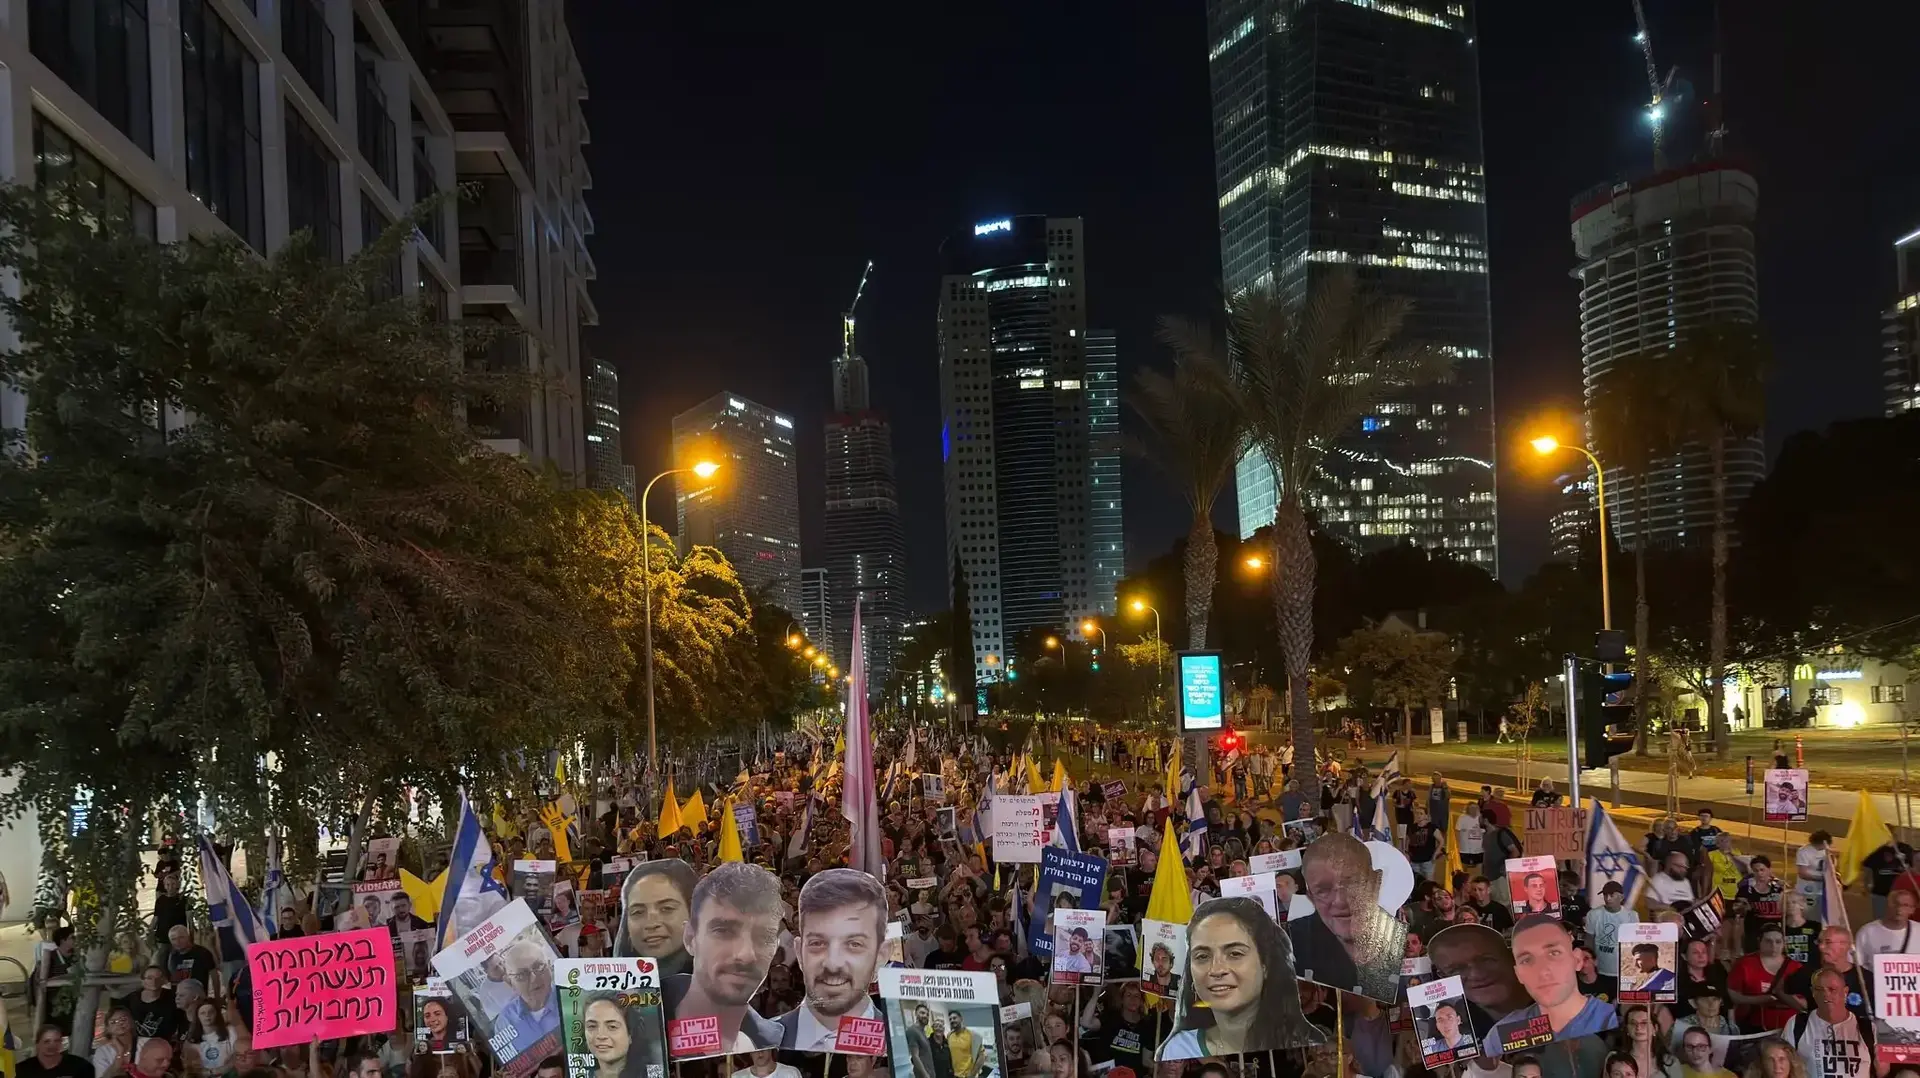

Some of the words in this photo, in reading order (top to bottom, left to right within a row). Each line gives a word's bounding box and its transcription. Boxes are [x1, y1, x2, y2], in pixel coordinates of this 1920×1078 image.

[1525, 809, 1546, 830] IN
[1047, 853, 1059, 863] בלי
[1060, 857, 1085, 869] ניצחון
[1044, 866, 1065, 878] גולדין
[1086, 863, 1101, 873] אין
[1065, 871, 1082, 882] הדר
[1083, 875, 1098, 885] סגן
[356, 880, 400, 893] KIDNAPP
[1035, 938, 1053, 951] נווה
[255, 940, 377, 973] במלחמה
[307, 966, 386, 993] תעשה
[595, 971, 652, 990] הילדה
[1884, 976, 1917, 991] איתי
[265, 971, 300, 1005] לך
[953, 988, 976, 1000] תמונת
[266, 996, 383, 1033] תחבולות
[683, 1018, 716, 1033] עדיין
[853, 1020, 885, 1034] עדיין
[488, 1024, 519, 1051] BRING
[1503, 1039, 1529, 1052] בעזה
[497, 1044, 518, 1064] HIM
[568, 1053, 595, 1068] BRNG
[1823, 1057, 1862, 1078] קרט
